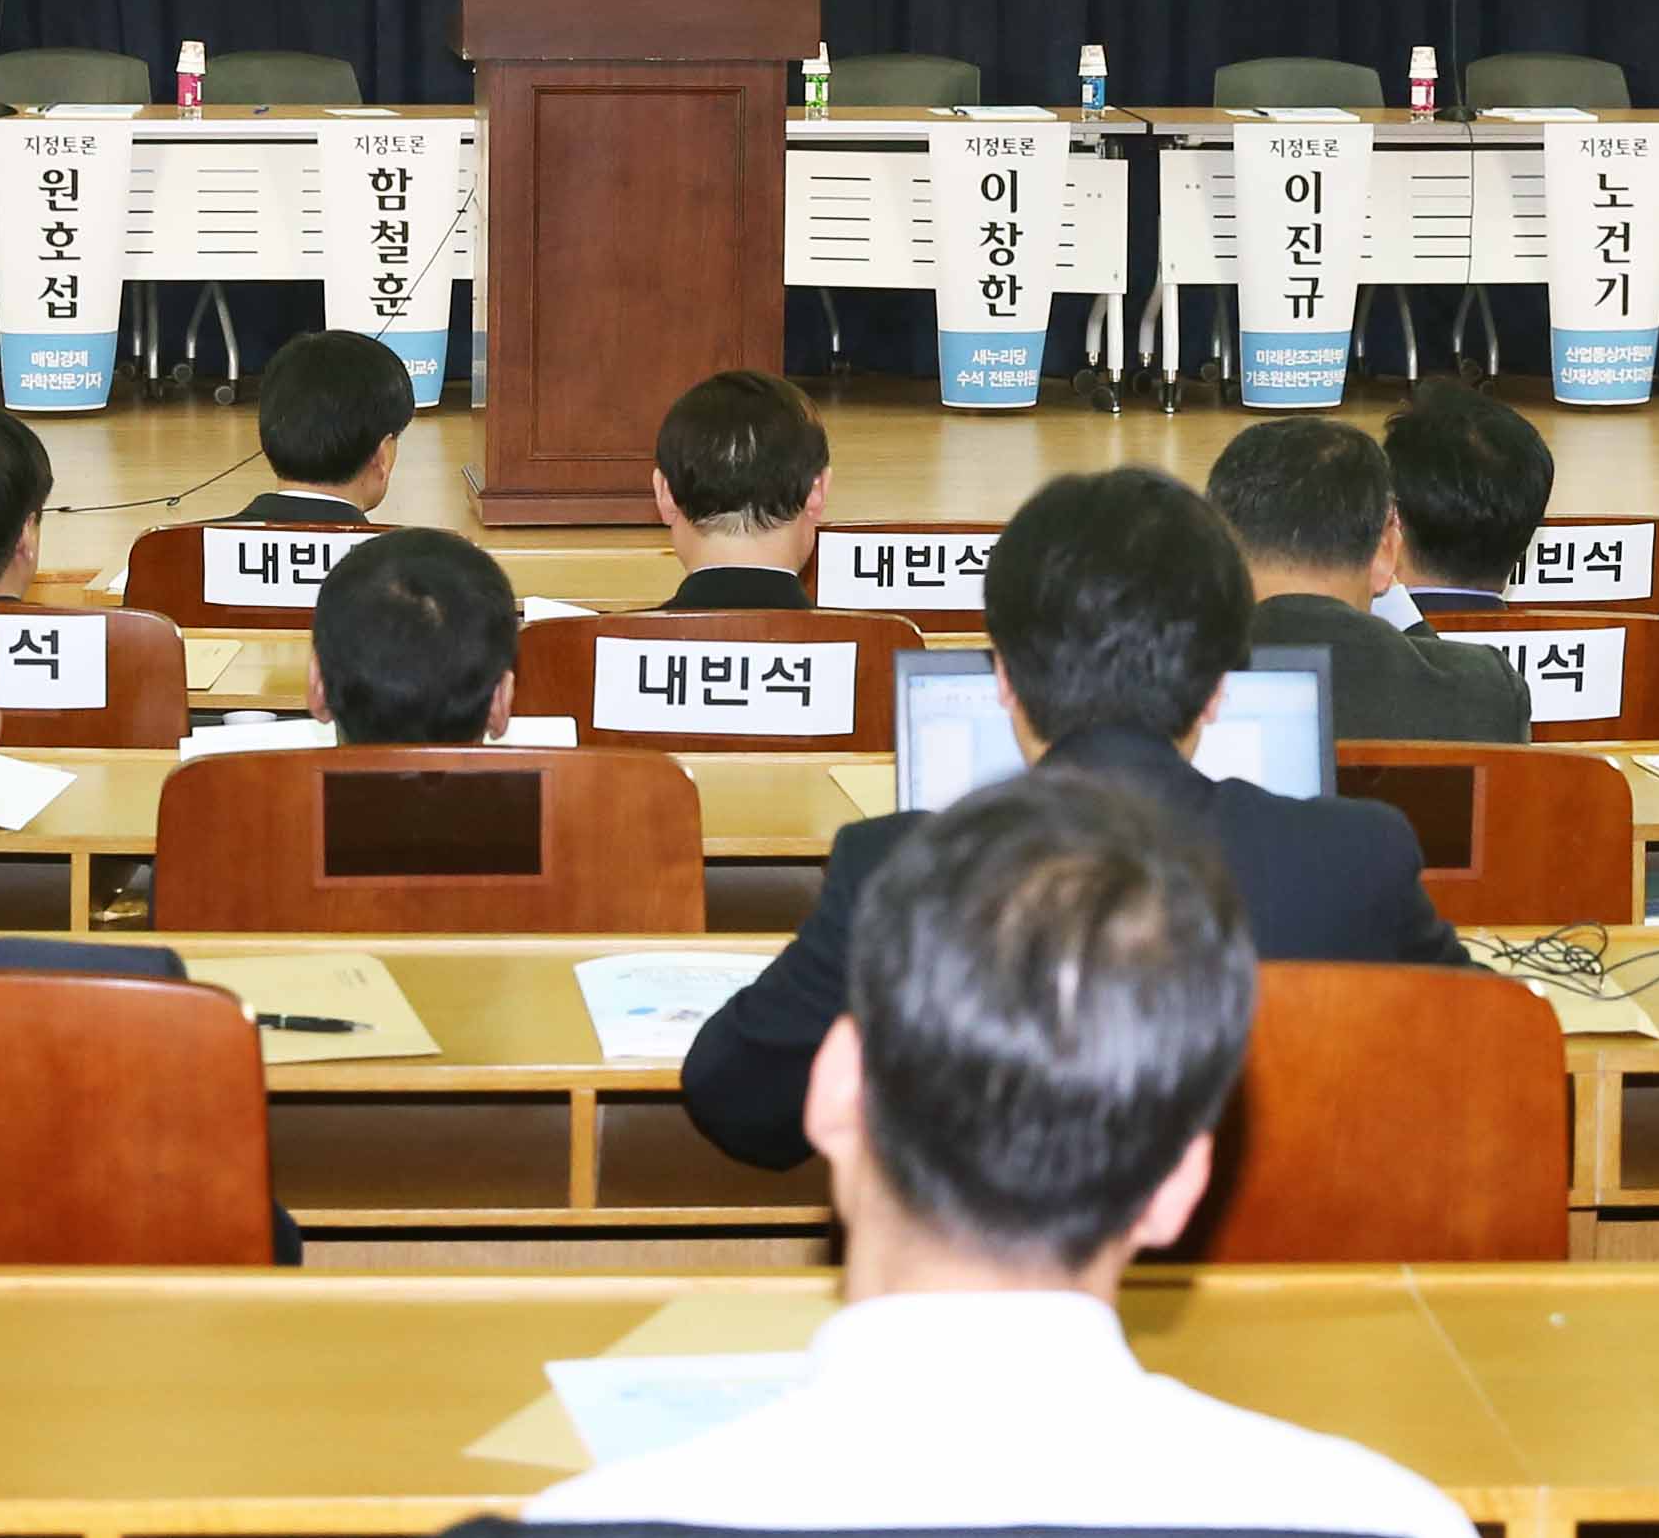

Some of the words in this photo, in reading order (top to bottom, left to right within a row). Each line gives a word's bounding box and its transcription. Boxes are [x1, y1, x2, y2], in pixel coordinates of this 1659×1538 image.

[23, 135, 97, 156] 지정토론
[354, 134, 425, 156] 지정토론
[963, 136, 1037, 158] 지정토론
[1268, 138, 1340, 159] 지정토론
[1579, 137, 1648, 158] 지정토론
[38, 168, 81, 318] 원호섭
[368, 168, 412, 317] 함철훈
[979, 169, 1023, 317] 이창한
[1284, 171, 1324, 318] 이진규
[1594, 174, 1634, 316] 노건기
[31, 350, 89, 368] 매일경제
[972, 347, 1027, 366] 새누리당
[956, 369, 985, 388] 수석
[238, 541, 331, 584] 내빈
[638, 654, 812, 707] 내빈석
